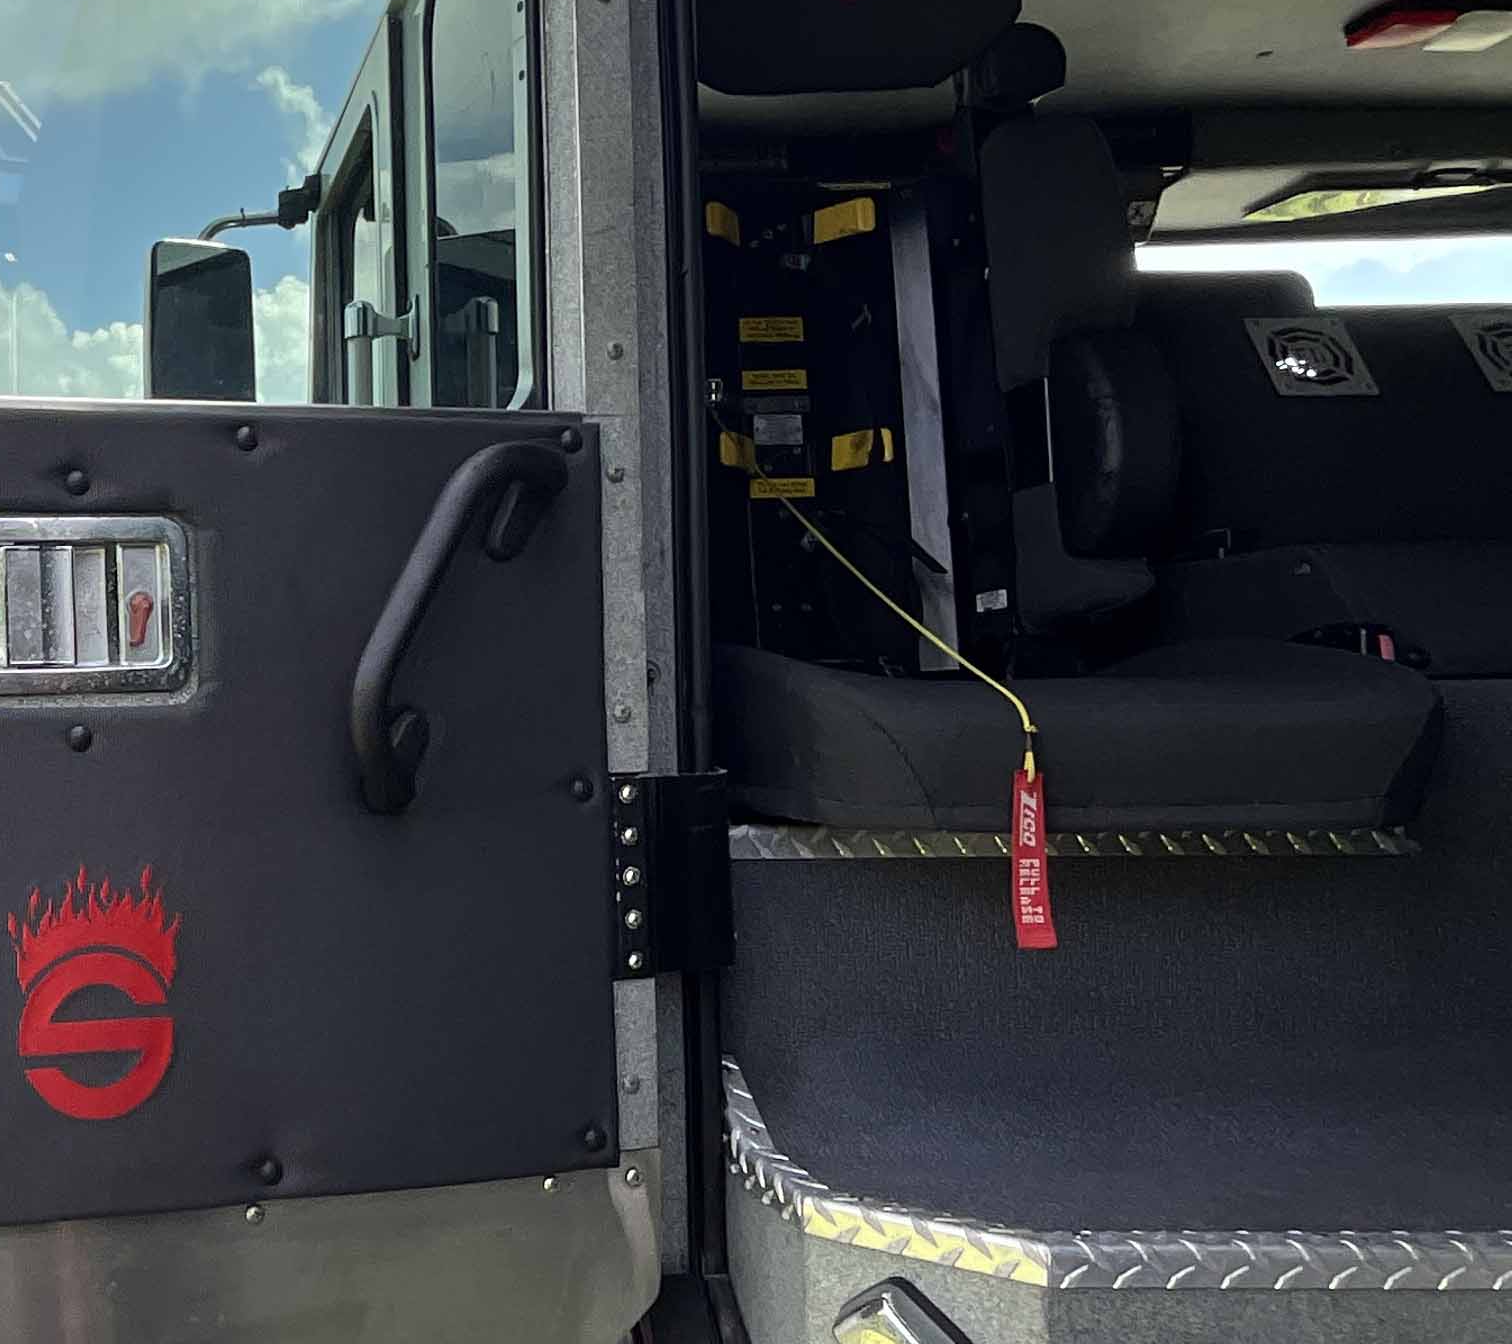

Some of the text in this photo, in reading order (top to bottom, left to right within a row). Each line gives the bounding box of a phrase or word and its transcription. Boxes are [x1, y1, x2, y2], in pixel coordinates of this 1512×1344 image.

[1019, 858, 1034, 924] RELEASE
[1028, 858, 1045, 924] PULL TO
